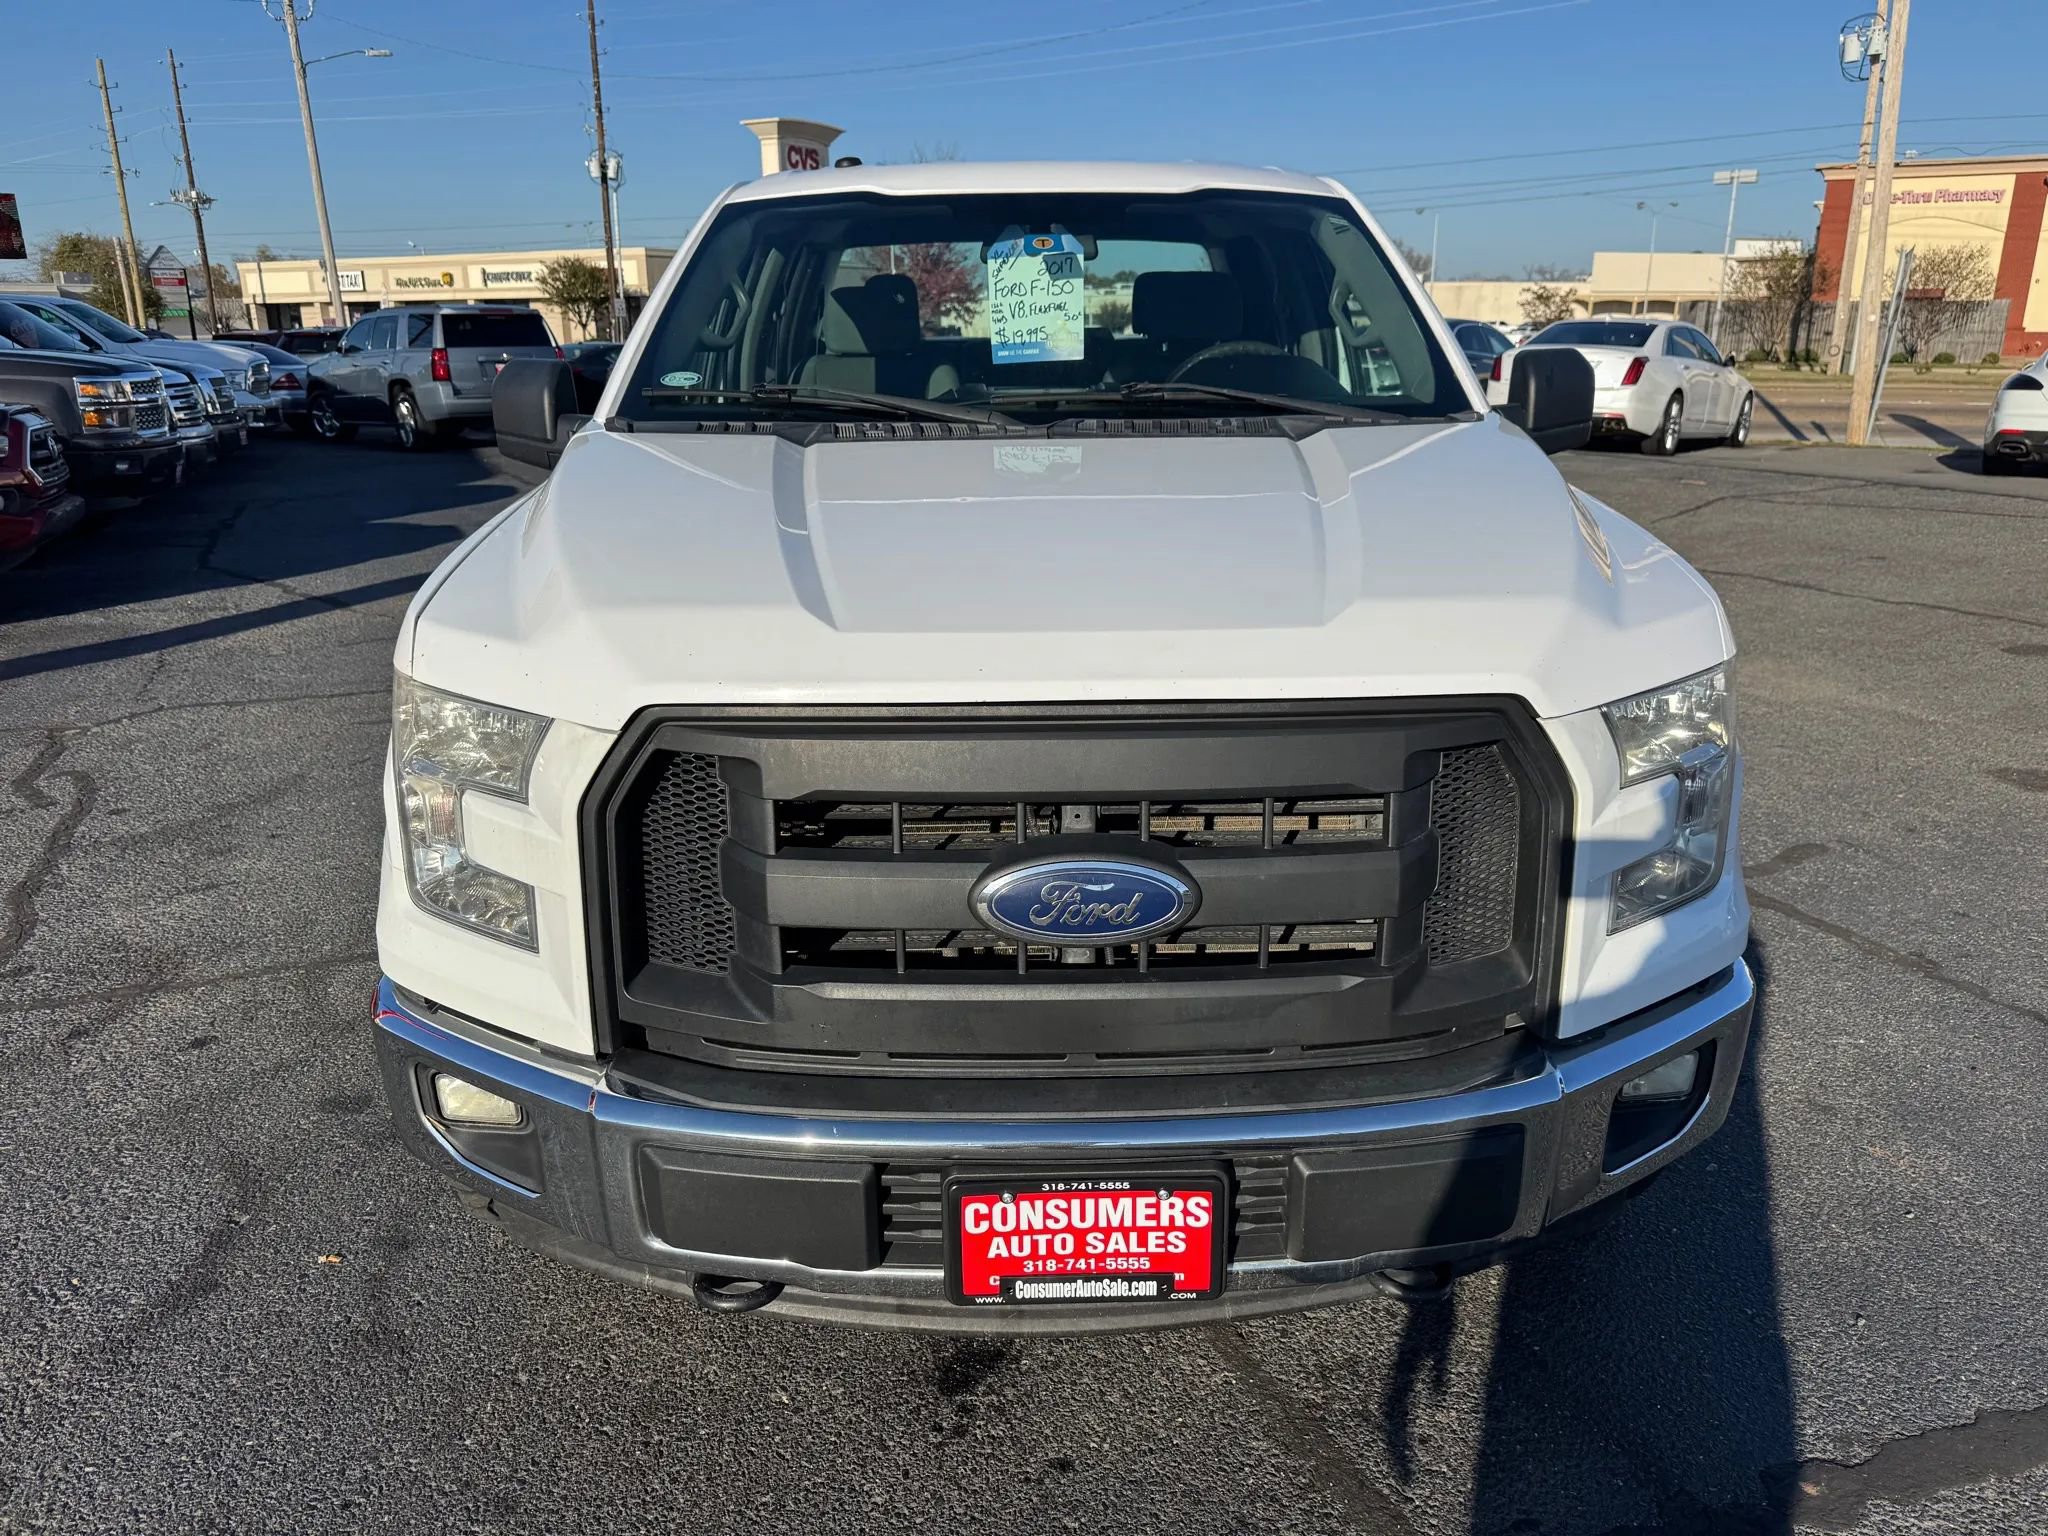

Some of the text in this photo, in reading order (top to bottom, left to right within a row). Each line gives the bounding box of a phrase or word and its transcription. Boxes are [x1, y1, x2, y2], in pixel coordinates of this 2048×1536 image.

[787, 144, 819, 170] CVS
[1934, 188, 2006, 203] Pharmacy
[1037, 256, 1074, 276] 2017
[994, 278, 1075, 300] FORD F-150
[1029, 880, 1143, 926] Ford
[1041, 1181, 1131, 1191] 318-741-5555
[964, 1196, 1210, 1234] CONSUMERS
[987, 1231, 1187, 1258] AUTO SALES
[1022, 1256, 1151, 1273] 318-741-5555
[1015, 1279, 1158, 1299] ConsumerAutoSale.com
